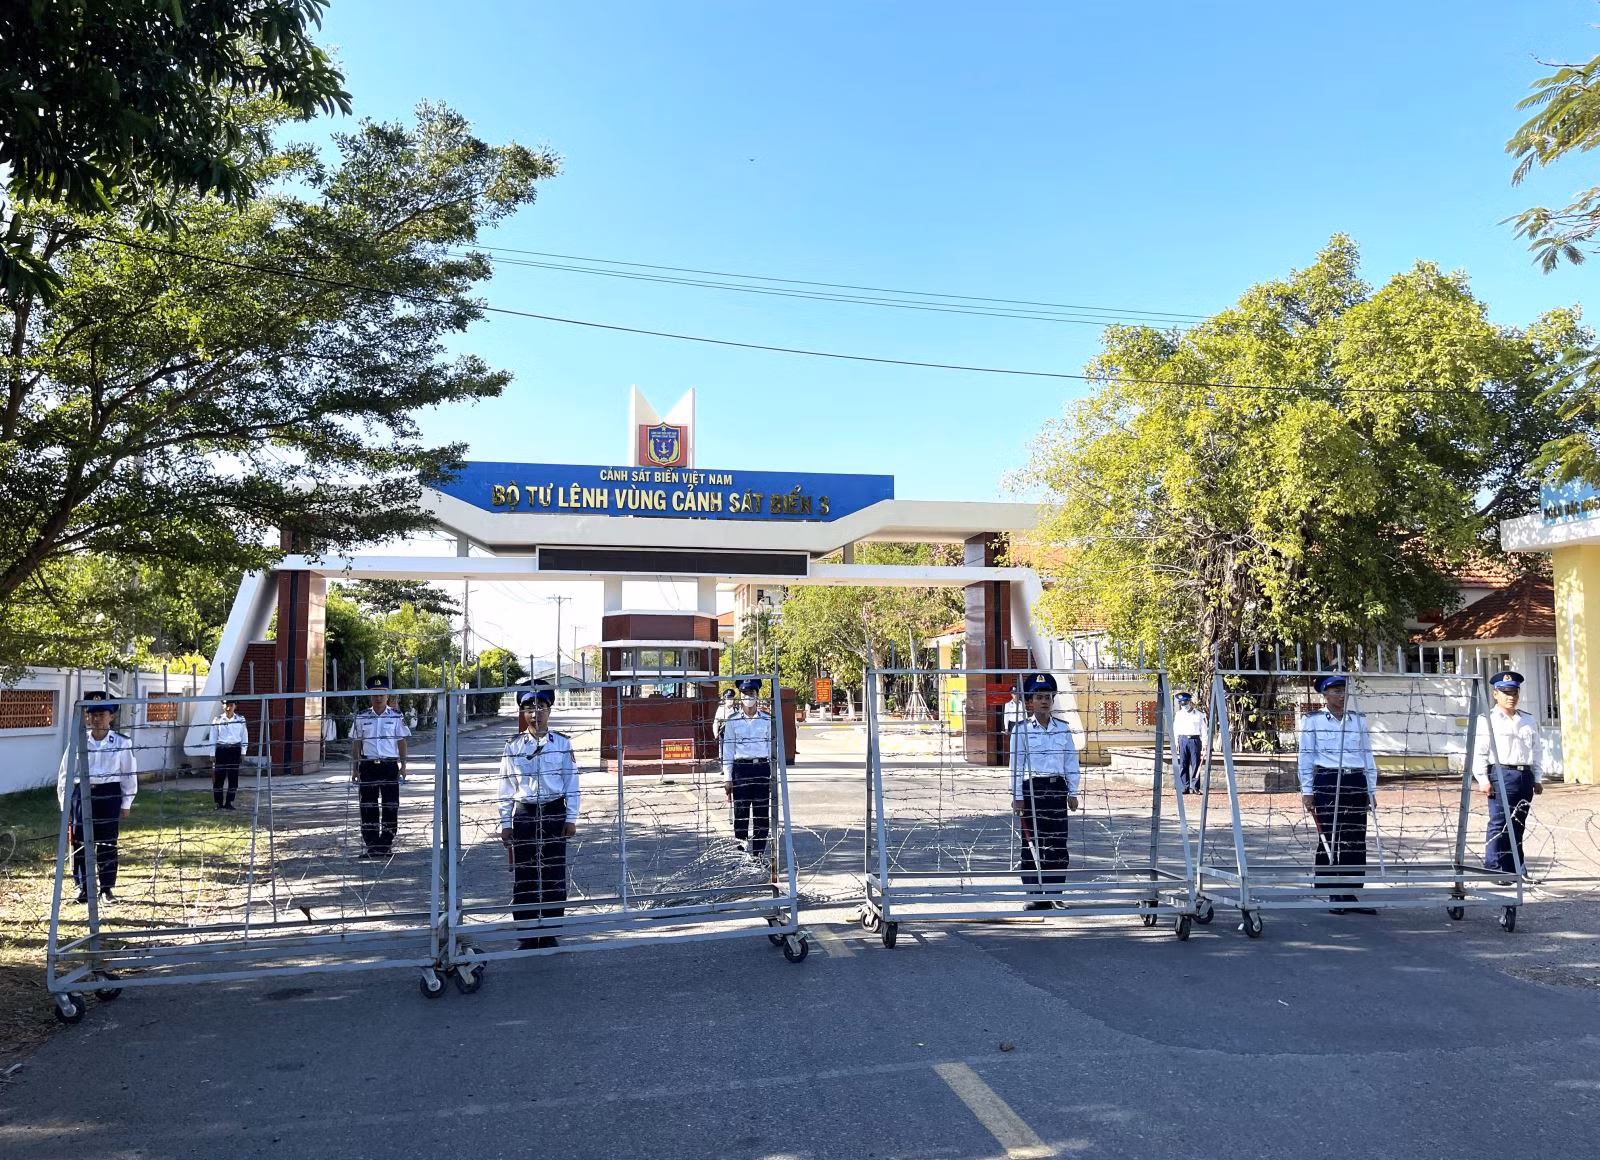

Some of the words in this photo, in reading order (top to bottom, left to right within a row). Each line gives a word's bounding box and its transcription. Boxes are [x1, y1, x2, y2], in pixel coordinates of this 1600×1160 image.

[631, 469, 651, 482] SÁT
[654, 467, 679, 483] BIỂN
[682, 471, 706, 486] VIỆT
[709, 474, 733, 485] NAM
[492, 480, 520, 512] BỘ
[525, 482, 554, 507] TƯ
[614, 485, 667, 511] VÙNG
[672, 484, 723, 513] CẢNH
[729, 488, 763, 513] SÁT
[770, 484, 813, 515] BIỂN
[818, 495, 831, 515] 3
